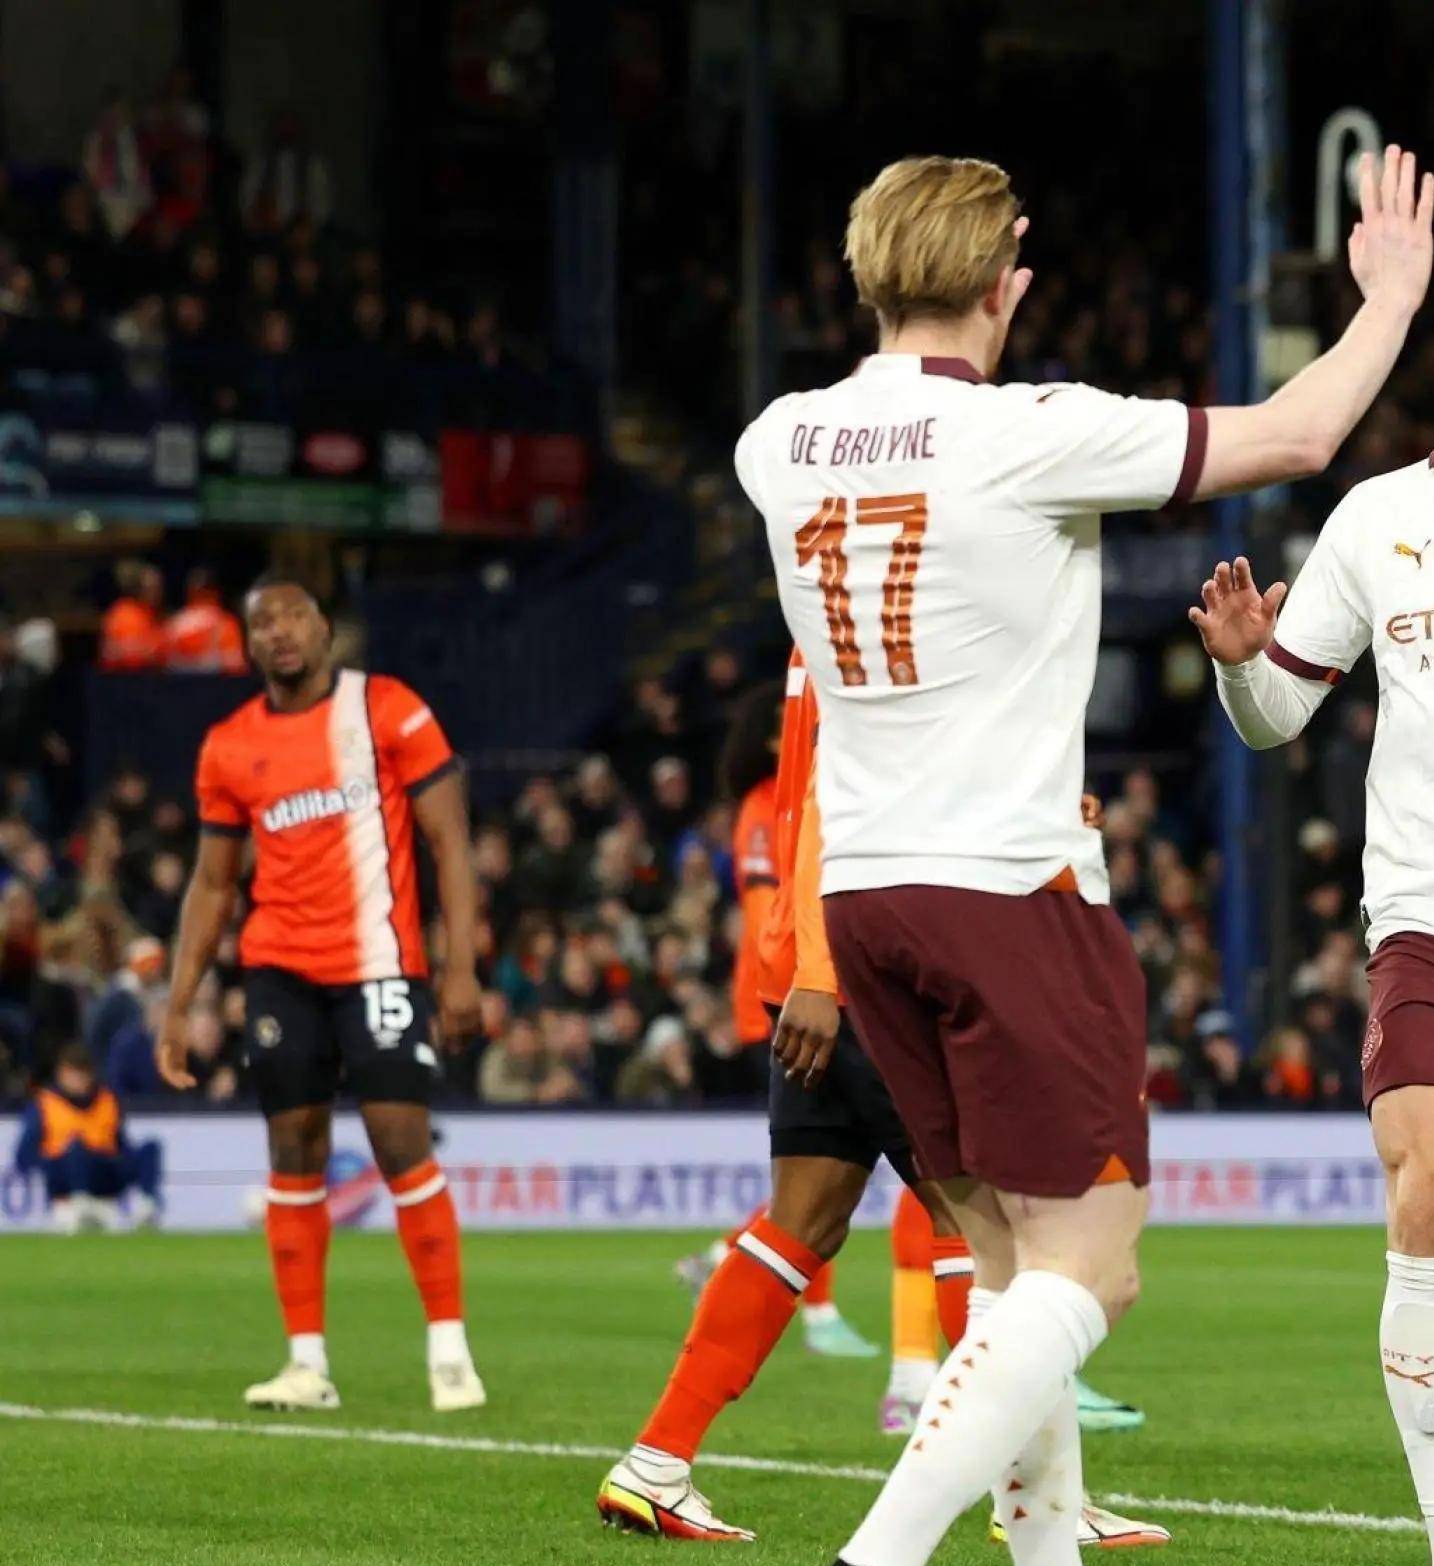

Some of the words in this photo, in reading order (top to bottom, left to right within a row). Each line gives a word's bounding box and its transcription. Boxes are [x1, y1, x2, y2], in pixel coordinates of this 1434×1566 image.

[791, 424, 825, 466] DE
[830, 417, 936, 466] BRUYNE
[795, 493, 927, 685] 17
[361, 979, 414, 1036] 15
